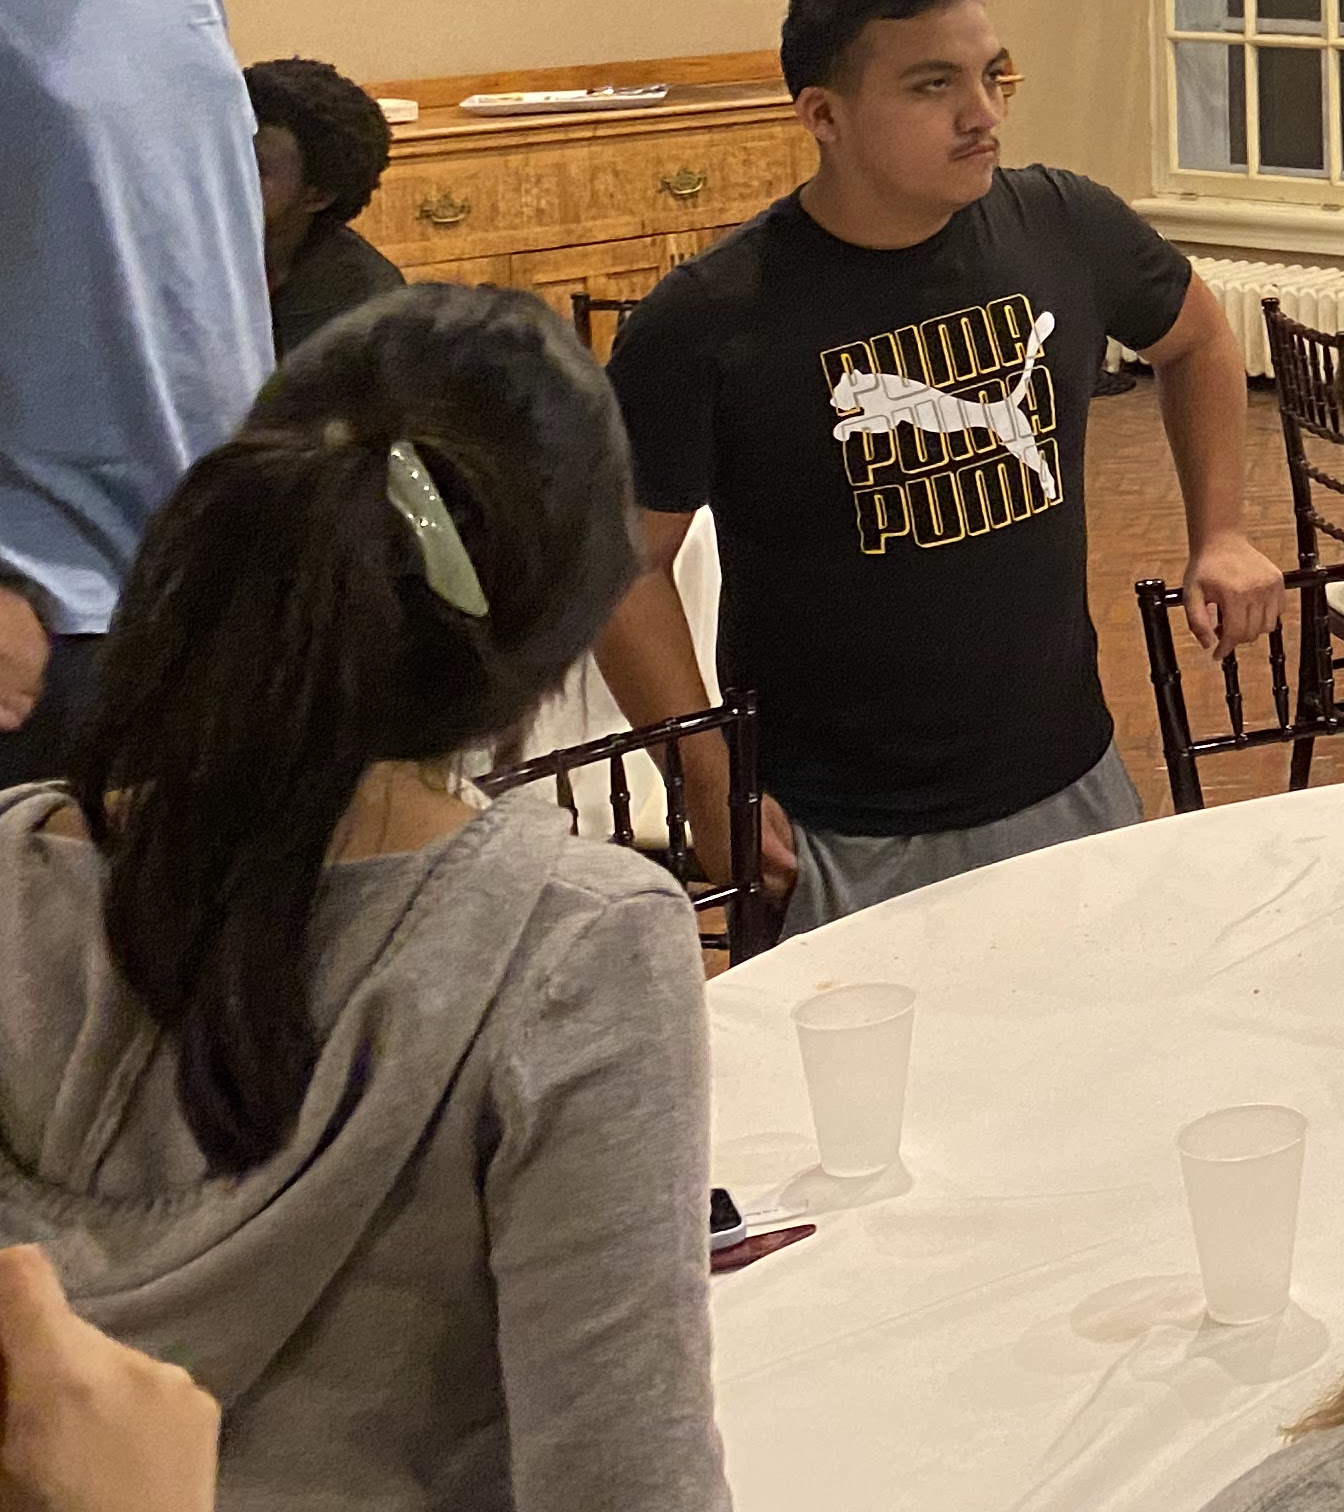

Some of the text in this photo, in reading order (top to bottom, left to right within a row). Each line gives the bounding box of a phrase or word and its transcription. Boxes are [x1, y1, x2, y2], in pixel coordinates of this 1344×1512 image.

[820, 293, 1045, 416] PUMA
[843, 364, 1057, 486] PUMA
[853, 437, 1064, 555] PUMA
